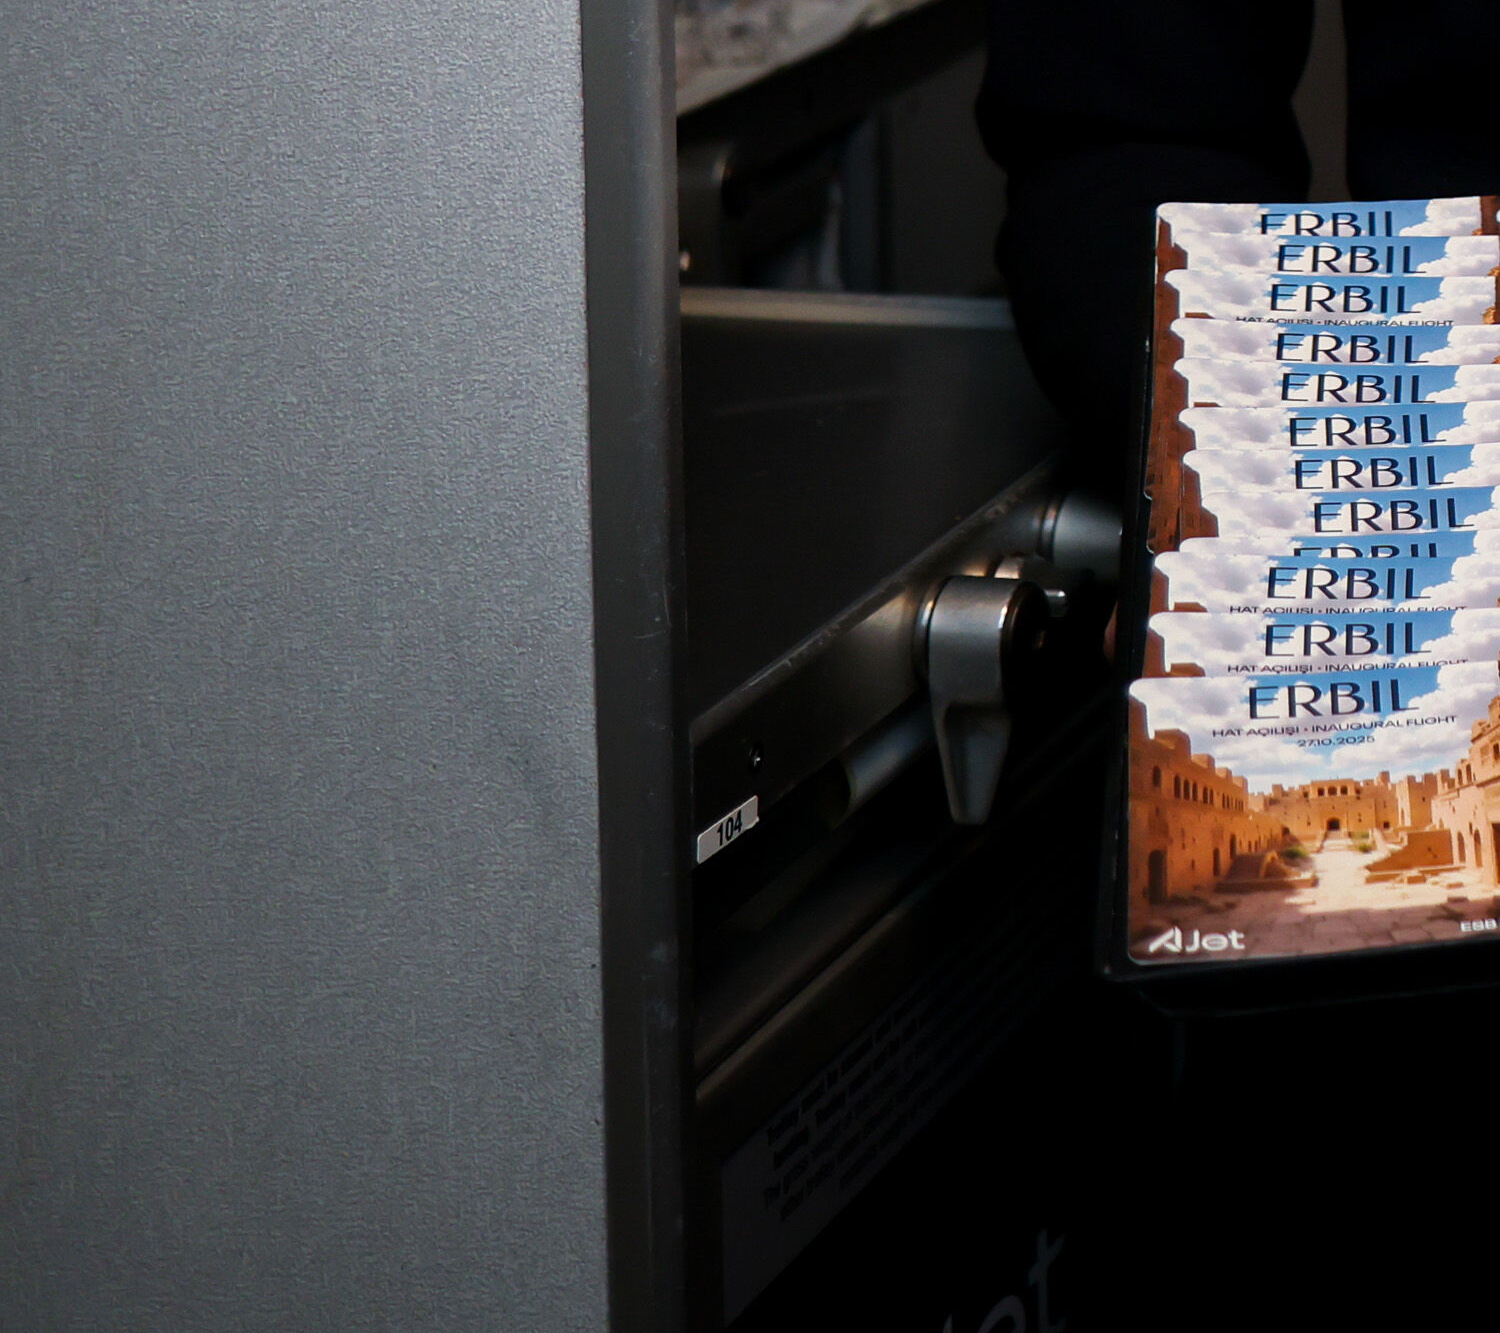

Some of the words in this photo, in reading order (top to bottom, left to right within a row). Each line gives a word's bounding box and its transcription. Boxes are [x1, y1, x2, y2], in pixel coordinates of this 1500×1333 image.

[1277, 244, 1427, 274] ERBIL
[1270, 284, 1422, 314] ERBIL
[1275, 333, 1429, 363] ERBIL
[1281, 373, 1436, 404] ERBIL
[1289, 414, 1447, 447] ERBIL
[1295, 455, 1454, 490] ERBIL
[1314, 497, 1475, 533] ERBIL
[1267, 566, 1432, 600] ERBIL
[1265, 622, 1432, 657] ERBIL
[1249, 678, 1420, 720] ERBIL
[1212, 729, 1245, 738] HAT
[1311, 719, 1402, 733] INAUGURAL
[1406, 715, 1458, 727] FLIGHT
[717, 809, 743, 846] 104
[1148, 926, 1246, 953] AJet
